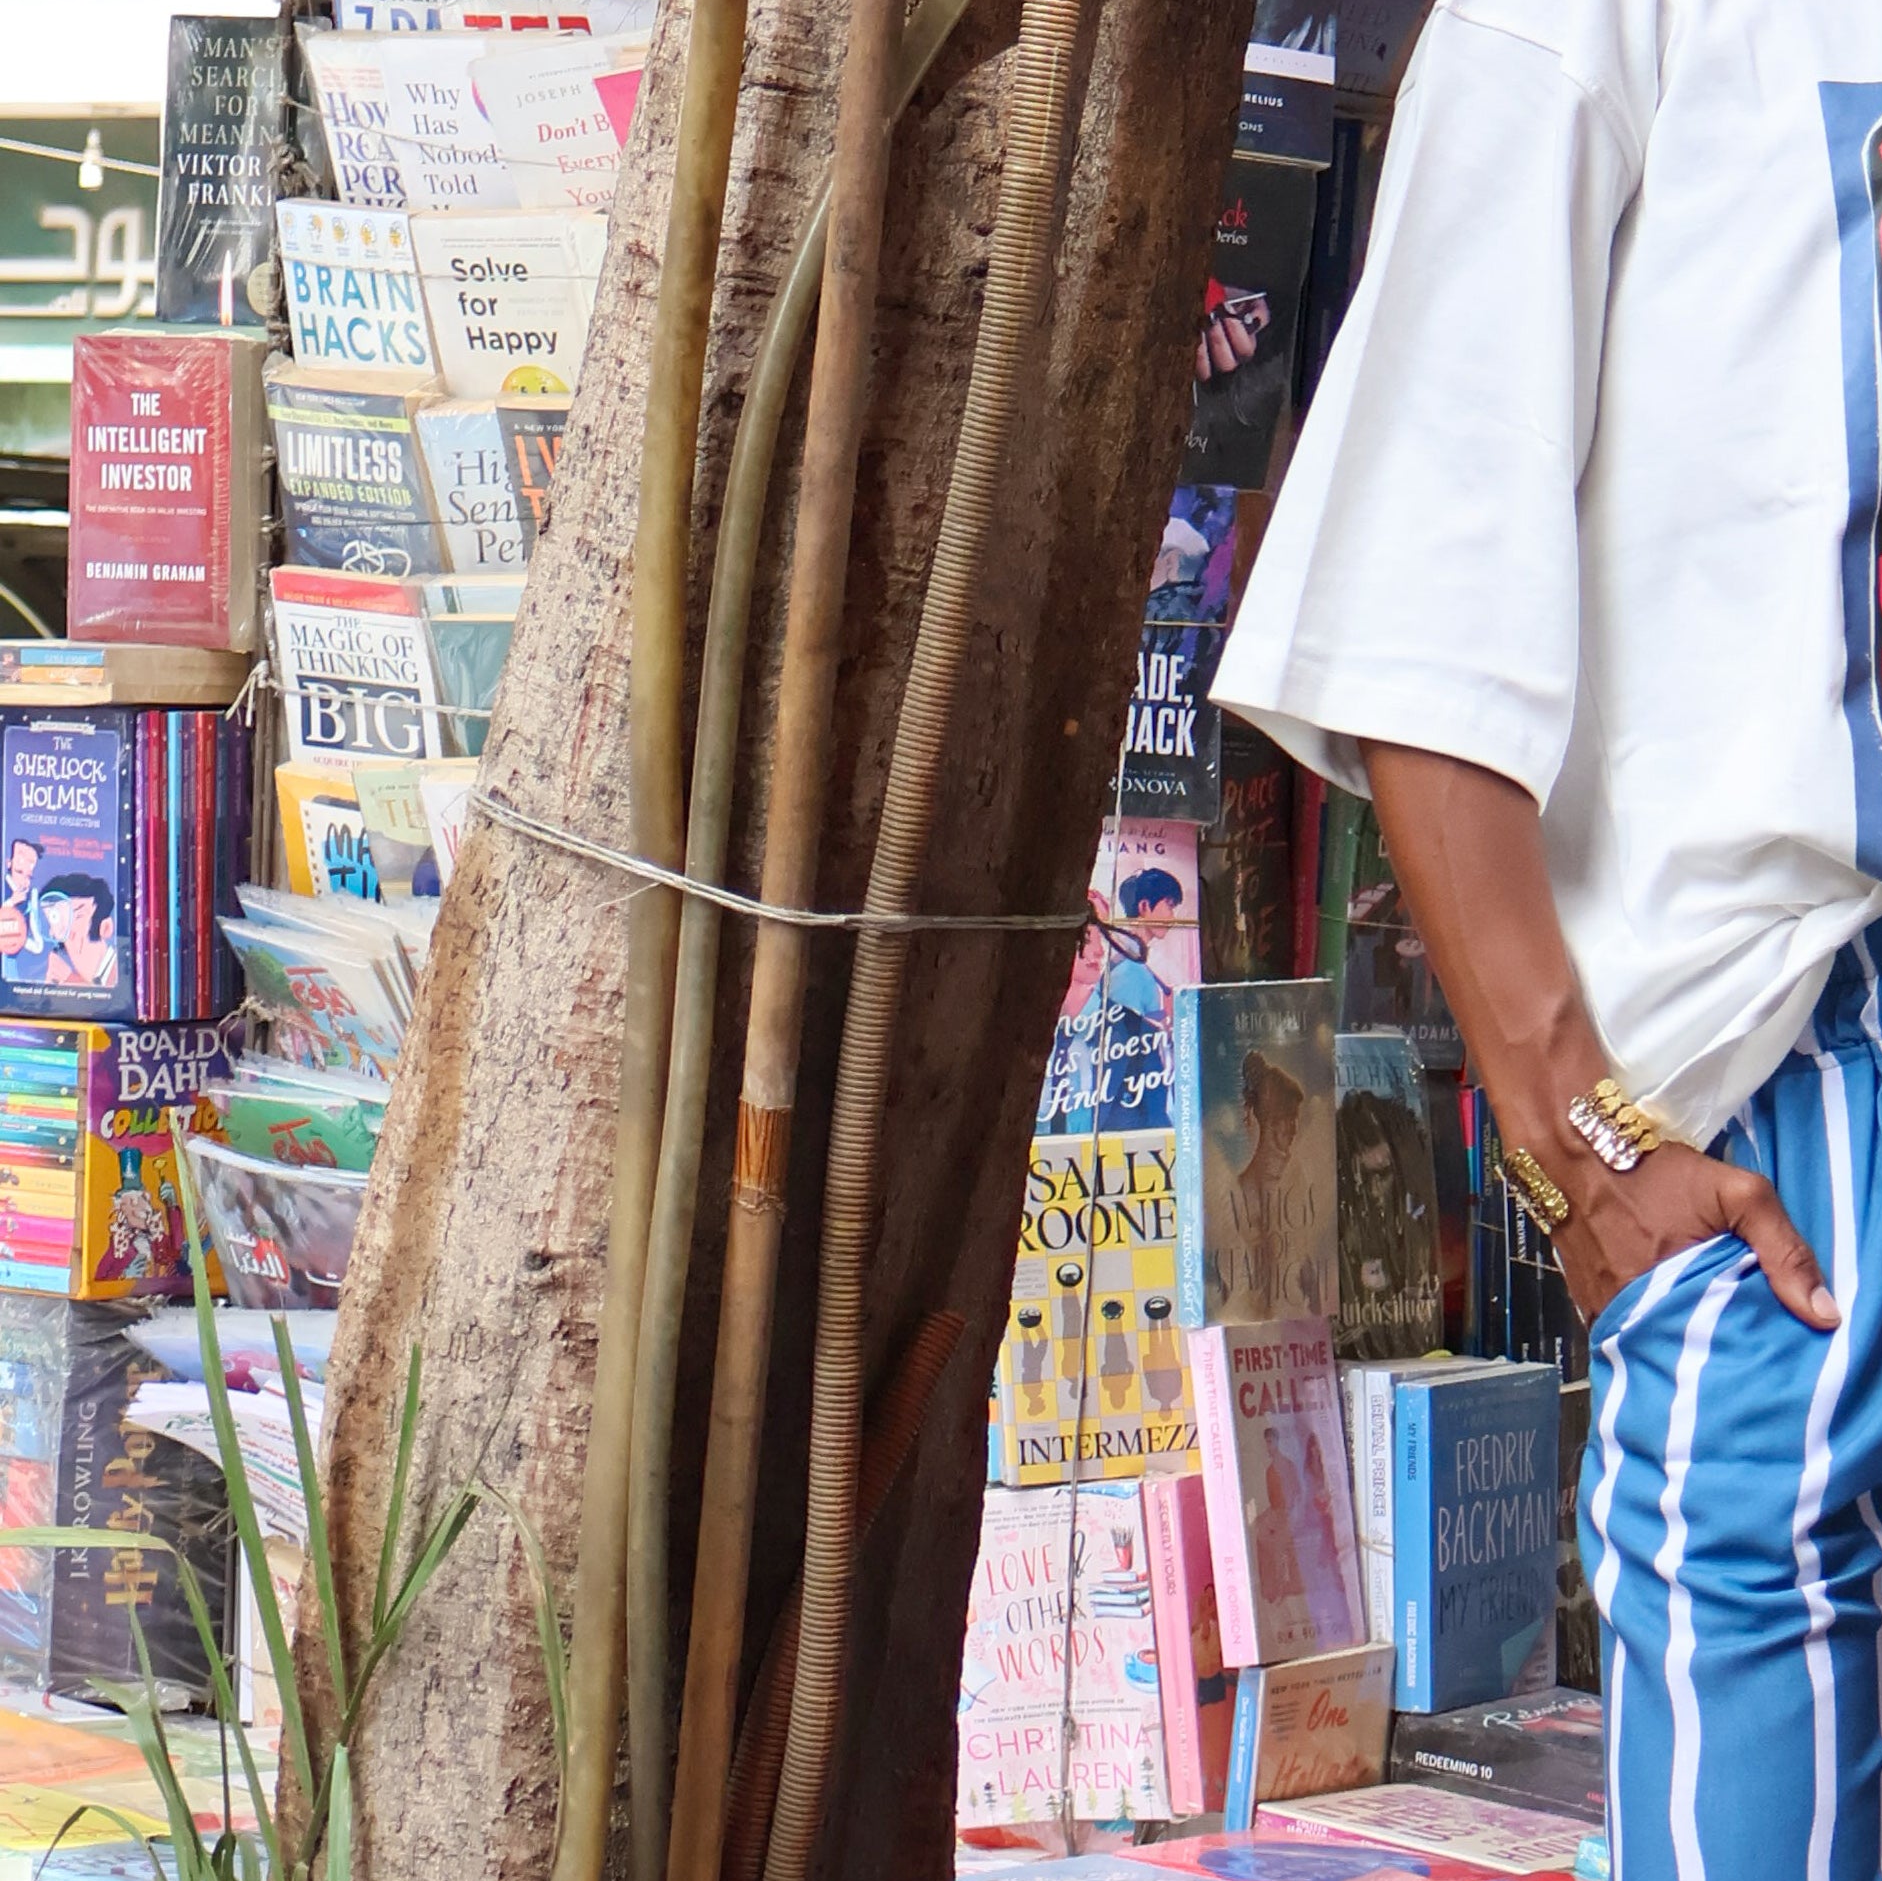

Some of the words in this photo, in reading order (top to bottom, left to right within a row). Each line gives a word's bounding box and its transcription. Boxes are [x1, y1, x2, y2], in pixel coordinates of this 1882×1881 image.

[214, 96, 259, 116] FOR
[405, 83, 461, 110] Why
[516, 85, 583, 108] JOSEPH
[179, 124, 276, 146] MEANIN
[413, 113, 459, 137] Has
[538, 119, 589, 143] Don't
[337, 131, 398, 162] REA
[419, 144, 499, 167] Nobod
[176, 154, 261, 178] VIKTOR
[425, 174, 478, 196] Told
[292, 261, 416, 313] BRAIN
[451, 258, 529, 282] Solve
[458, 290, 497, 316] for
[298, 313, 427, 365] HACKS
[466, 327, 558, 355] Happy
[131, 393, 161, 416] THE
[88, 426, 207, 455] INTELLIGENT
[287, 431, 403, 485] LIMITLESS
[101, 464, 192, 492] INVESTOR
[290, 479, 354, 503] EXPANDED
[357, 485, 413, 508] EDITION
[86, 562, 148, 581] BENJAMIN
[153, 564, 206, 582] GRAHAM
[336, 617, 361, 629] THE
[290, 624, 373, 655] MAGIC
[383, 635, 415, 659] OF
[291, 649, 419, 684] THINKING
[302, 682, 422, 756] BIG
[53, 736, 73, 751] THE
[13, 752, 107, 783] SHERLOCK
[22, 782, 98, 815] HOLMES
[118, 1028, 219, 1062] ROALD
[1180, 1017, 1190, 1059] WINGS
[1408, 1024, 1460, 1042] ADAMS
[118, 1061, 209, 1102] DAHL
[1181, 1062, 1190, 1084] OF
[1037, 1078, 1112, 1123] find
[1123, 1066, 1176, 1105] you
[1181, 1085, 1191, 1156] STARLIGHT
[1028, 1148, 1177, 1204] SALLY
[1017, 1197, 1177, 1253] ROONE
[1337, 1290, 1438, 1330] uicksilver
[1202, 1351, 1215, 1386] FIRST
[1205, 1388, 1218, 1419] TIME
[1239, 1374, 1333, 1419] CALLER
[1371, 1394, 1385, 1455] BRUTAL
[1406, 1422, 1417, 1437] MY
[1018, 1420, 1200, 1466] INTERMEZZ
[1208, 1421, 1223, 1470] CALLER
[1406, 1438, 1417, 1481] FRIENDS
[72, 1401, 98, 1528] ROWLING
[1456, 1428, 1537, 1497] FREDRIK
[1372, 1458, 1386, 1517] PRINCE
[1158, 1499, 1172, 1552] SECRETLY
[1437, 1487, 1551, 1572] BACKMAN
[986, 1543, 1057, 1596] LOVE
[1163, 1556, 1177, 1596] YOURS
[1006, 1588, 1087, 1635] OTHER
[1439, 1578, 1471, 1634] MY
[997, 1624, 1105, 1683] WORDS
[1307, 1689, 1350, 1732] One
[967, 1722, 1153, 1761] CHRITINA
[1415, 1751, 1479, 1778] REDEEMING
[1481, 1766, 1493, 1780] 10
